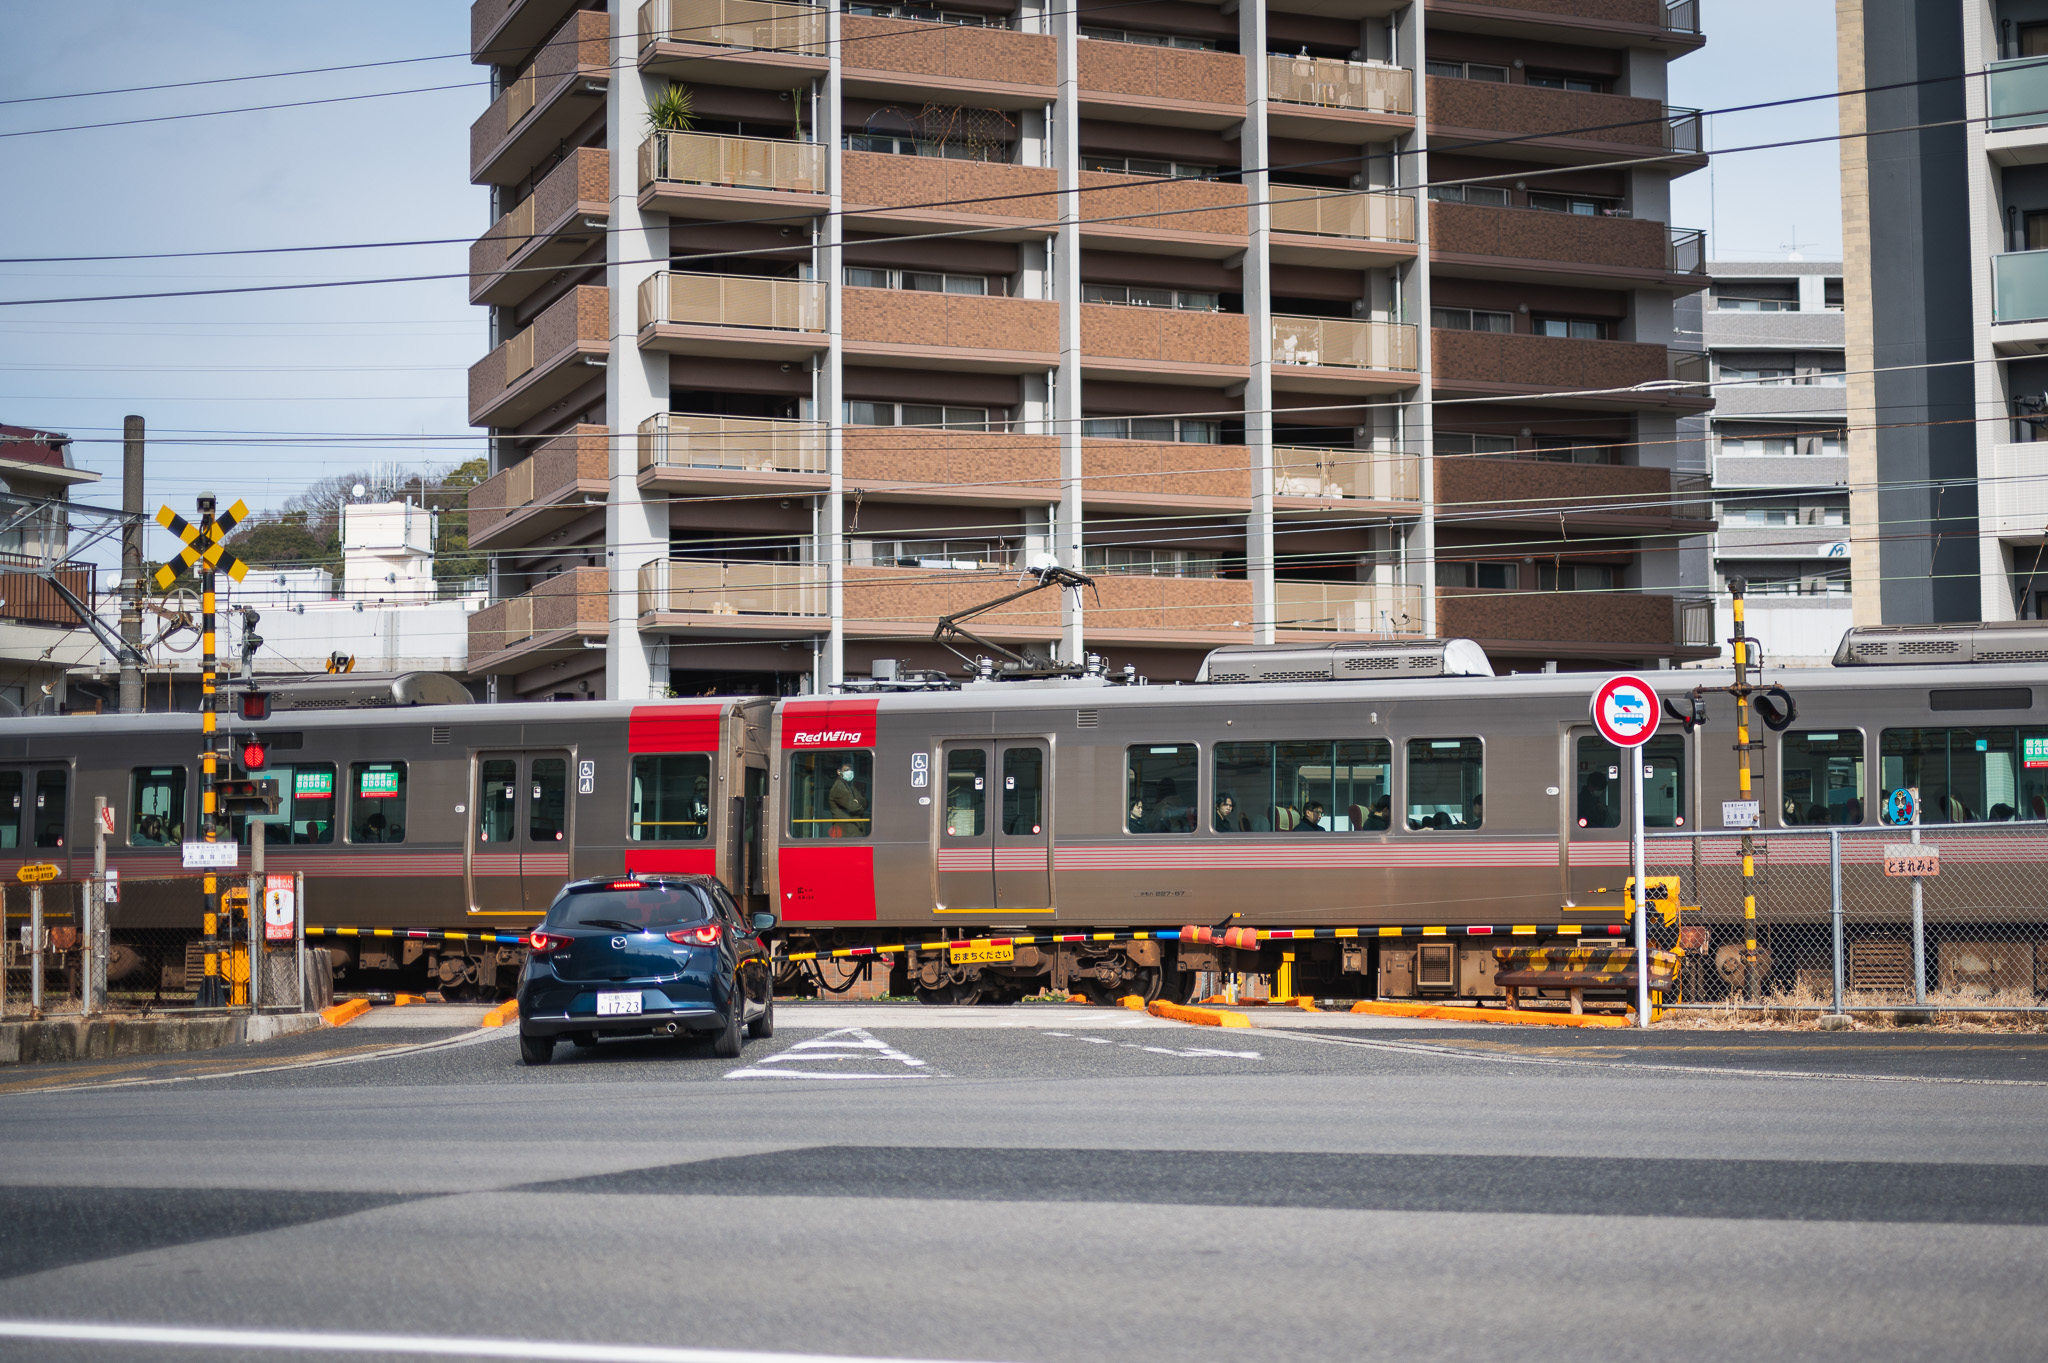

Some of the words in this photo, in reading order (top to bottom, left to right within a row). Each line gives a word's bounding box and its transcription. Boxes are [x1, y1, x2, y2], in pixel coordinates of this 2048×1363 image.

[1888, 860, 1935, 874] とまれみよ
[953, 951, 1011, 961] おまちください
